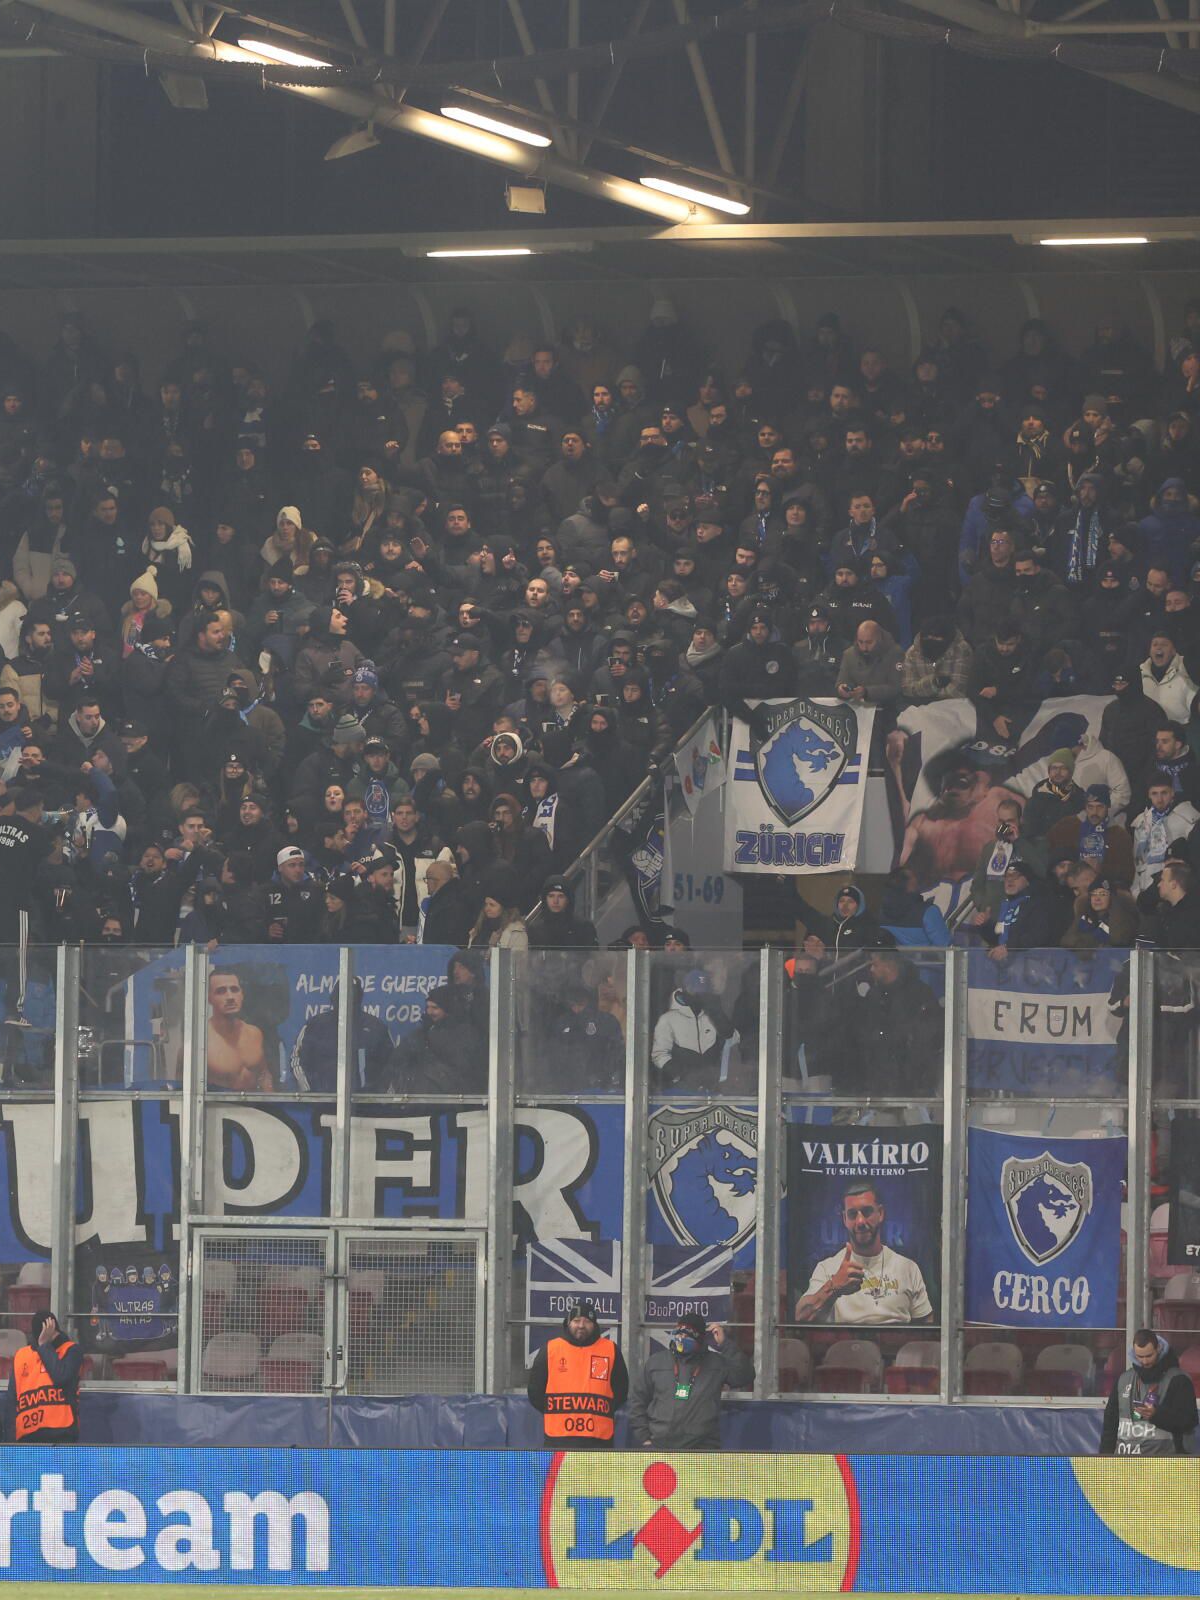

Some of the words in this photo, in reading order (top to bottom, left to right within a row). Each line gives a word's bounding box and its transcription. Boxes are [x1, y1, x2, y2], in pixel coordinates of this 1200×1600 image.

[0, 836, 15, 848] 1986
[735, 823, 846, 867] ZÜRICH
[268, 893, 282, 905] 12
[296, 973, 341, 995] ALM
[381, 974, 449, 999] GUERRE
[385, 1004, 424, 1022] COB
[655, 1117, 709, 1160] SUPER
[802, 1138, 929, 1165] VALKÍRIO
[825, 1168, 837, 1176] TU
[839, 1167, 868, 1176] SERÁS
[870, 1168, 905, 1176] ETERNO
[1008, 1165, 1041, 1194] SUPER
[992, 1271, 1091, 1315] CERCO
[113, 1300, 154, 1313] ULTRAS
[17, 1388, 65, 1411] EWARD
[547, 1396, 610, 1414] STEWARD
[22, 1410, 45, 1429] 297
[564, 1417, 595, 1432] 080
[1117, 1421, 1156, 1437] ITCH
[1117, 1442, 1141, 1455] 014
